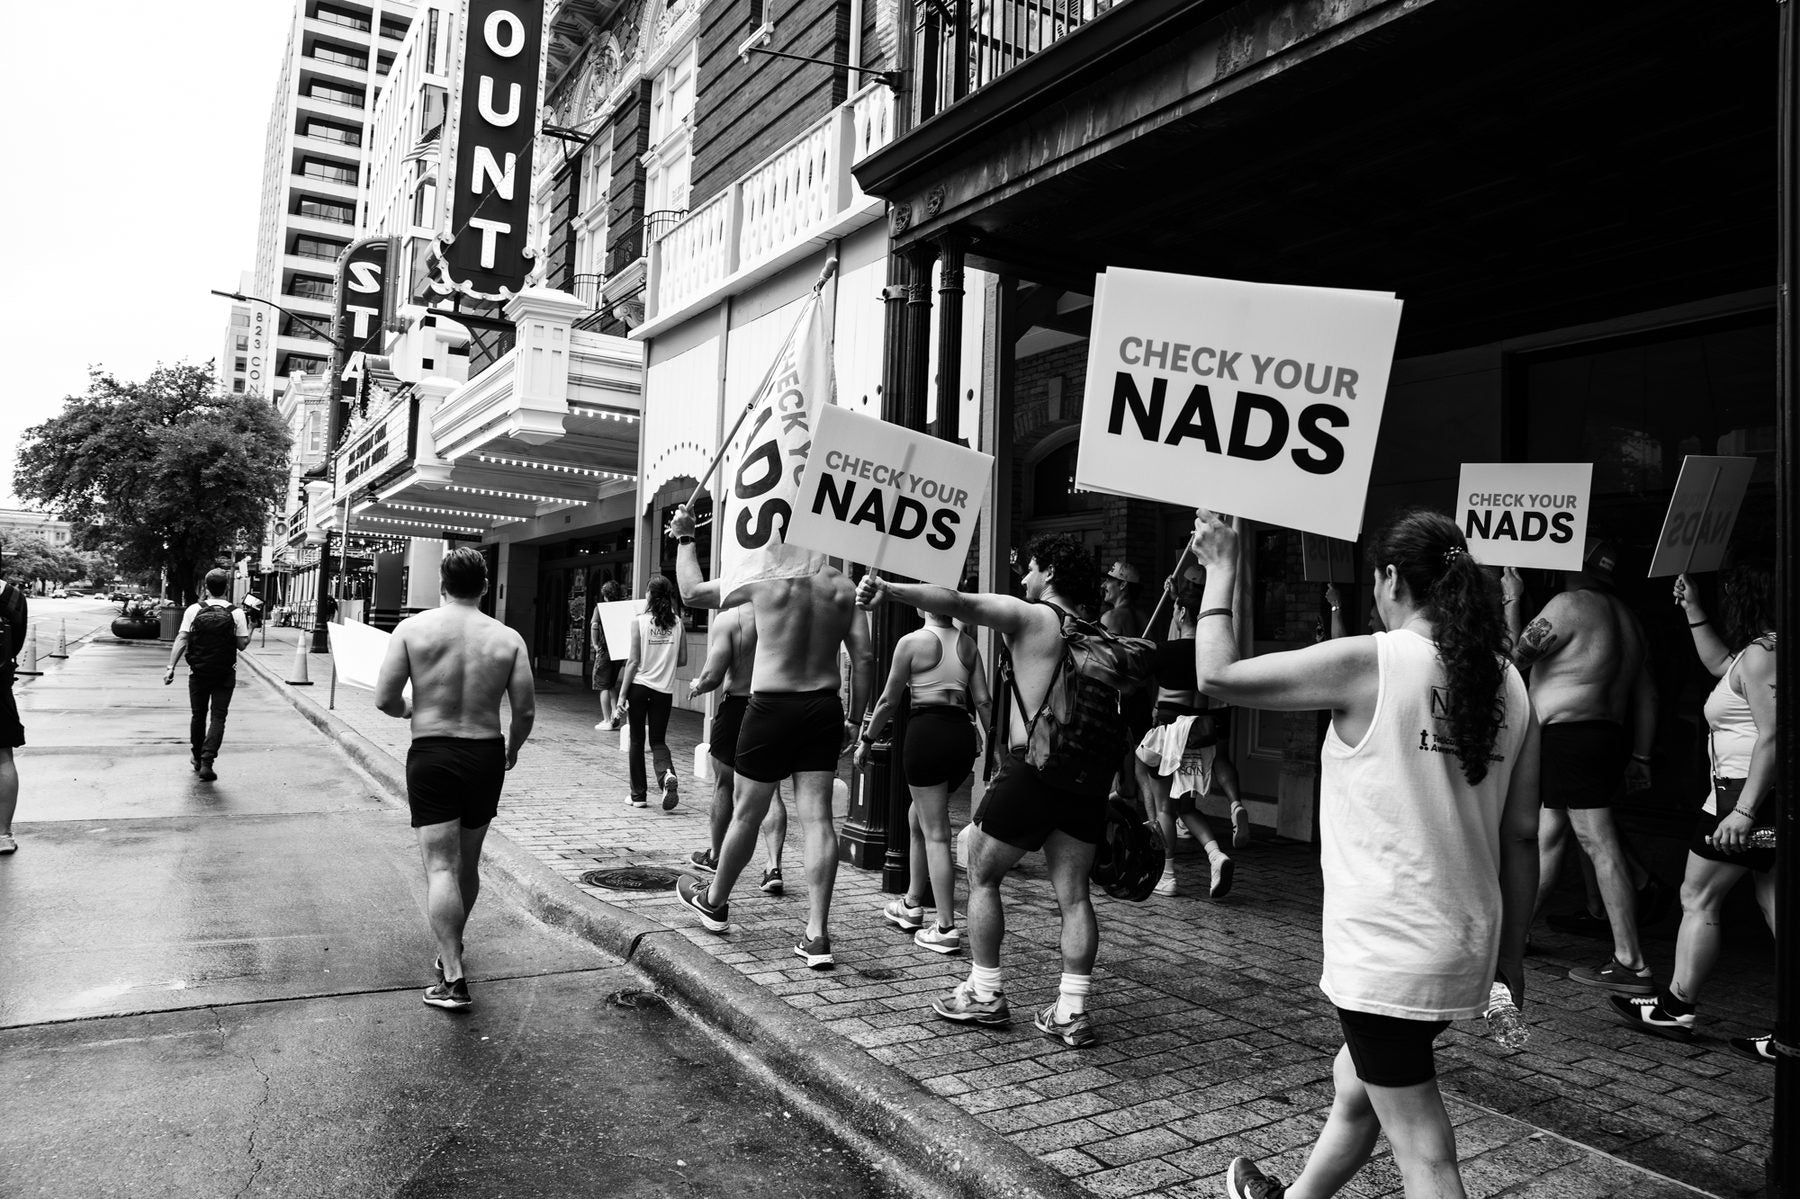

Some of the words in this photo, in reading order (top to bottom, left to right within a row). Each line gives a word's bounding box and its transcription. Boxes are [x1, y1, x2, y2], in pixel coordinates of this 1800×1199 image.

[254, 312, 263, 349] 823
[1119, 336, 1243, 382] CHECK
[1251, 354, 1360, 400] YOUR
[1107, 370, 1350, 475] NADS
[825, 450, 905, 489] CHECK
[909, 474, 969, 509] YOUR
[1468, 493, 1524, 508] CHECK
[1529, 494, 1577, 510] YOUR
[811, 472, 961, 552] NADS
[1465, 509, 1575, 544] NADS
